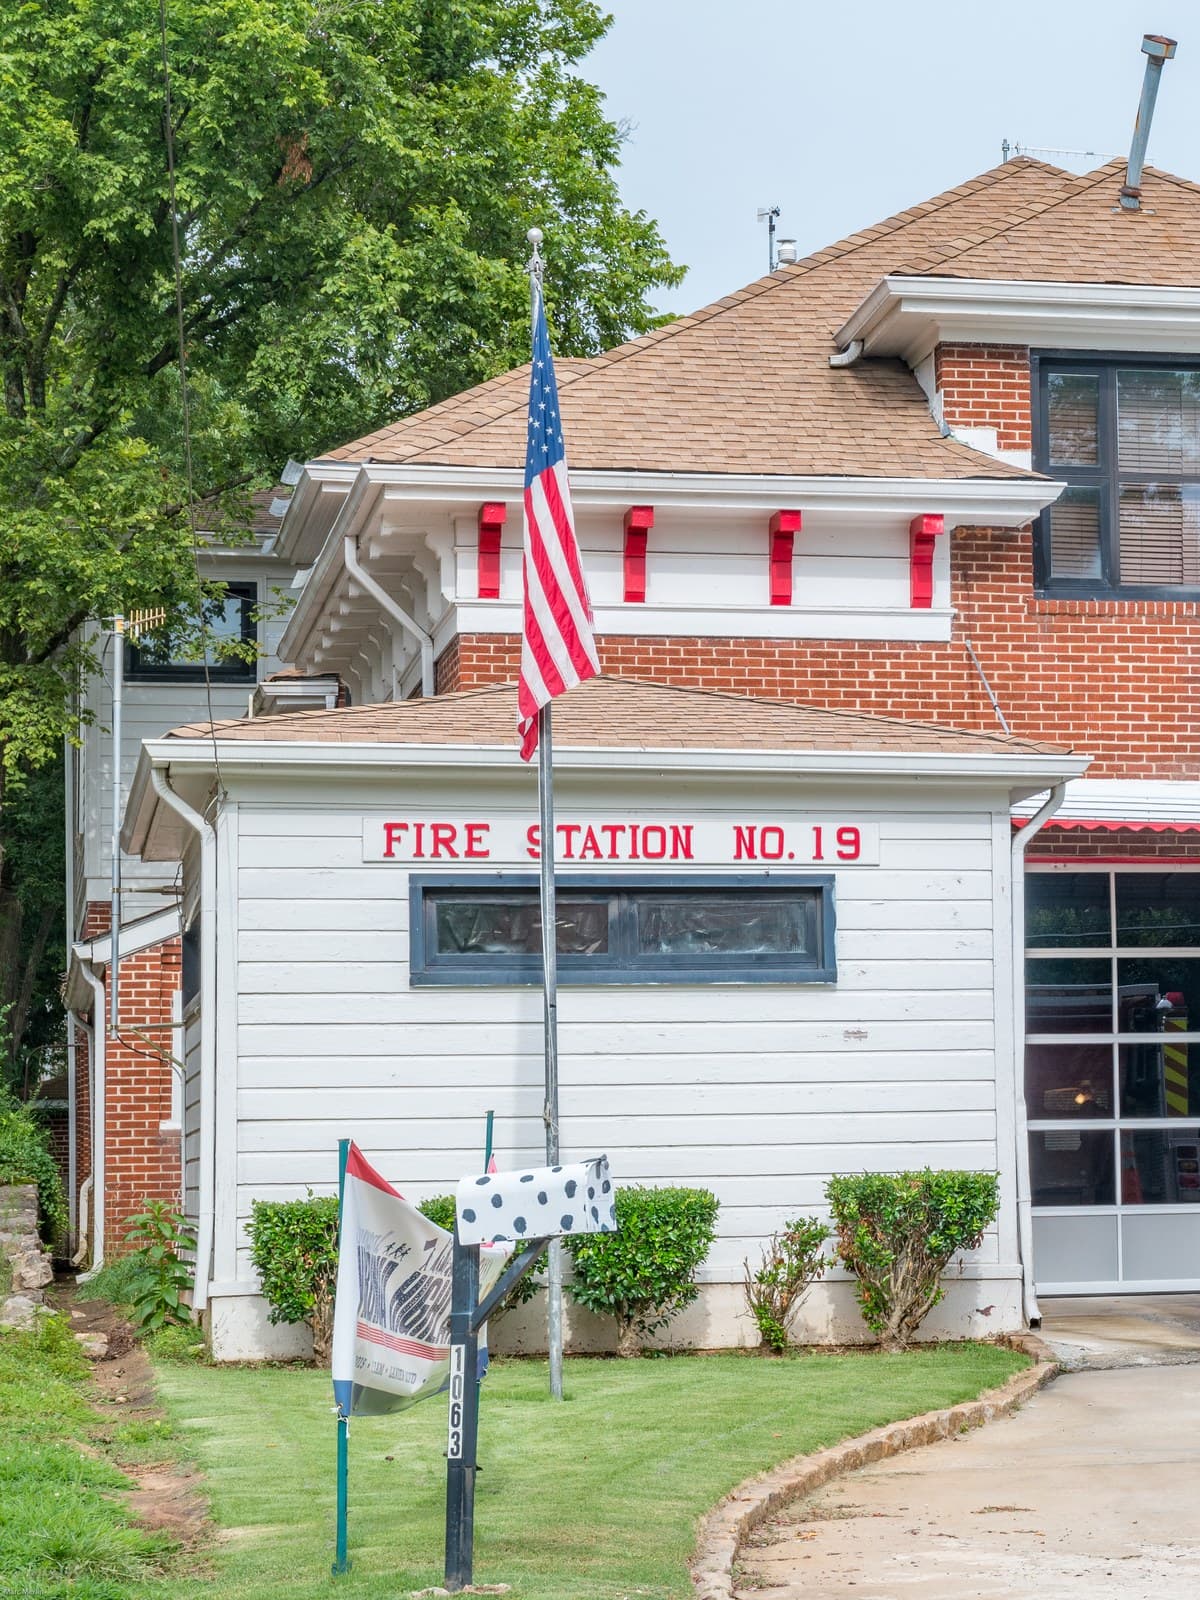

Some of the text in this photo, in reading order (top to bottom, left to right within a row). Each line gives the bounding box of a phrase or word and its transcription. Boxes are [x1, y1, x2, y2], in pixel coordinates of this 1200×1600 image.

[383, 822, 861, 860] FIRE STATION NO. 19
[449, 1346, 463, 1457] 1063
